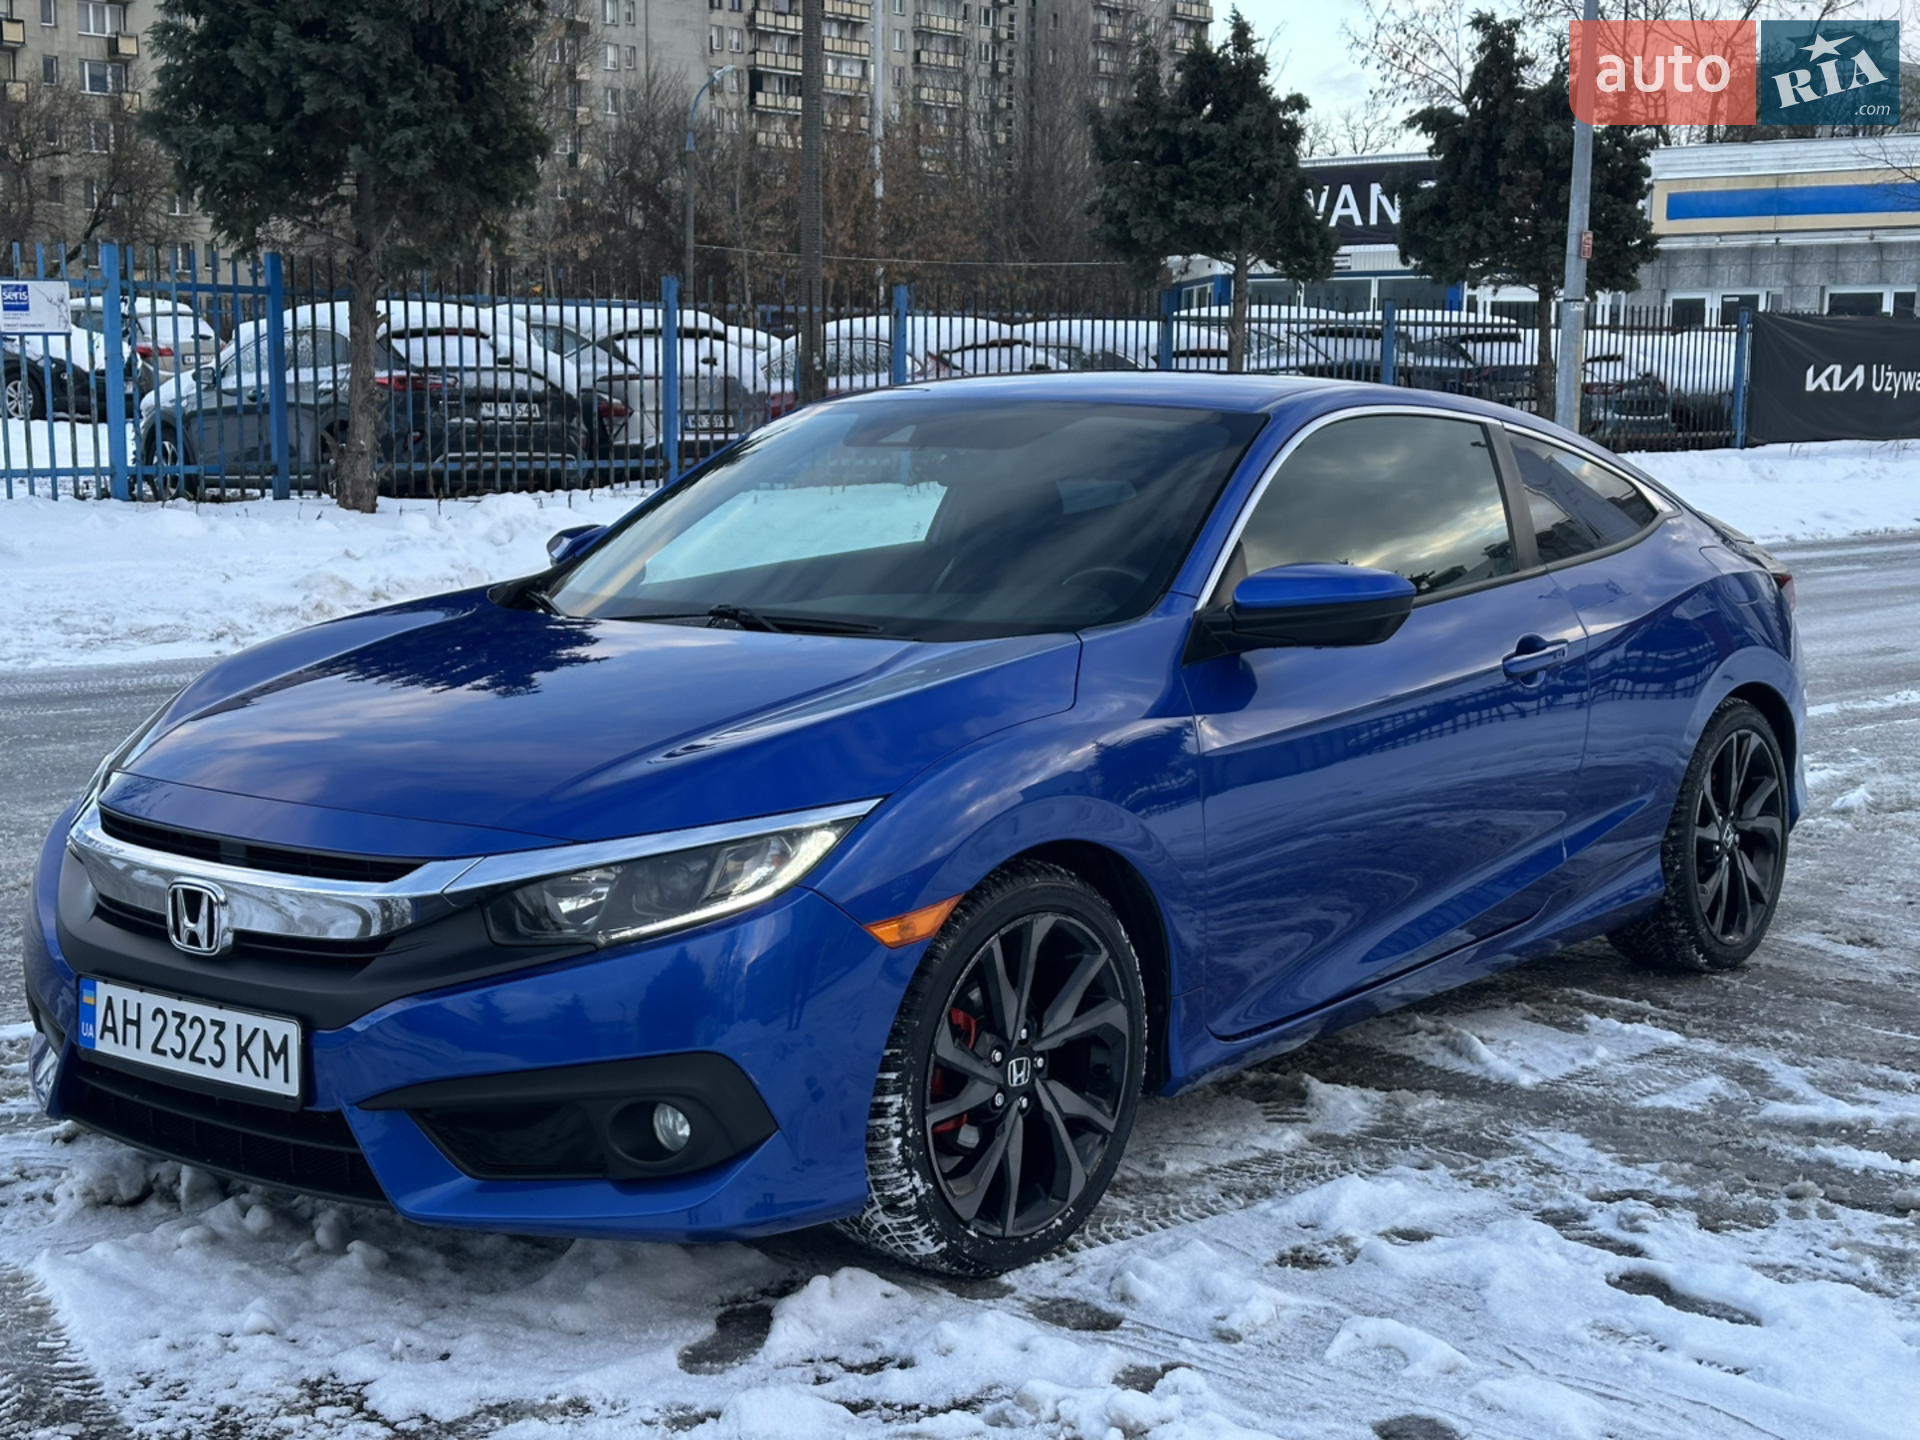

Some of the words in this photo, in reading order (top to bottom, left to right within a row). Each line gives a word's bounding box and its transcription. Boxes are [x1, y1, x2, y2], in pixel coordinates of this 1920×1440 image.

[3, 289, 28, 300] seris
[81, 1021, 95, 1039] UA
[99, 995, 142, 1050] AH
[150, 1007, 227, 1069] 2323
[236, 1023, 290, 1084] KM
